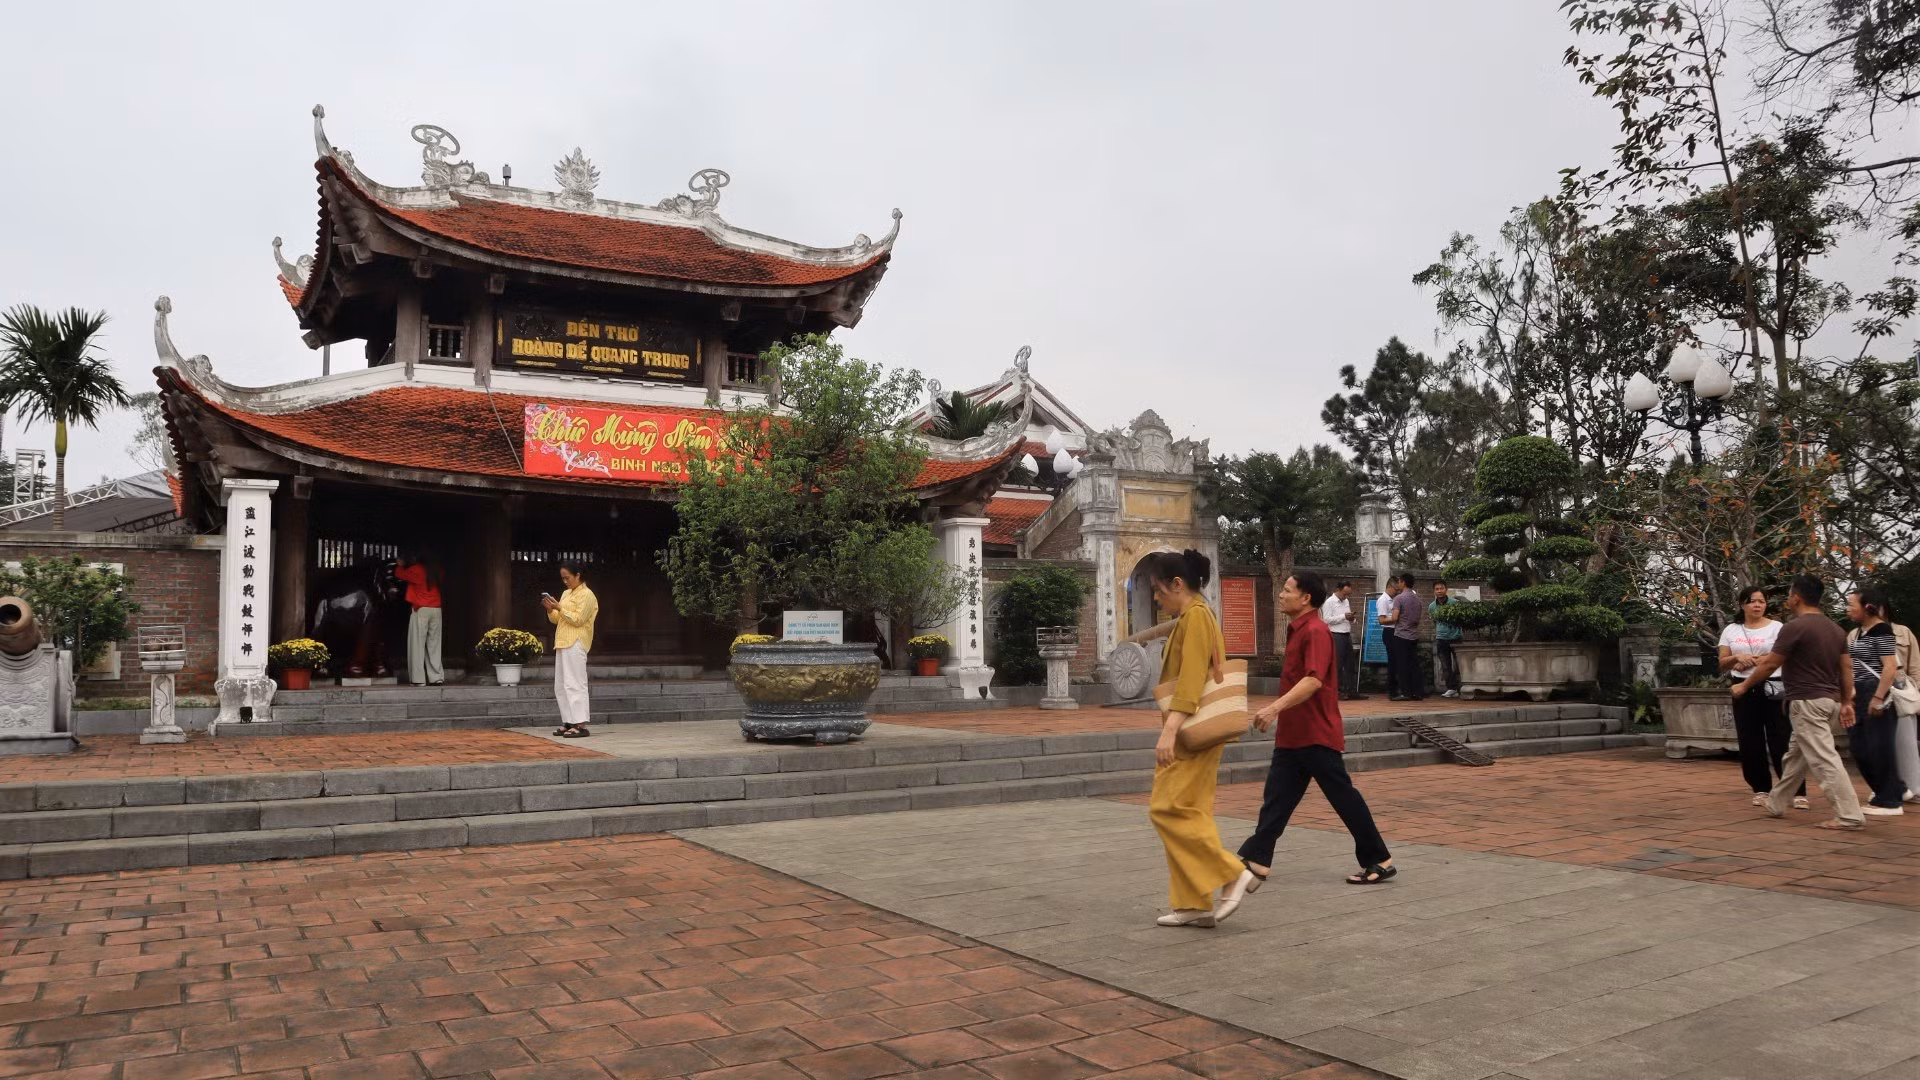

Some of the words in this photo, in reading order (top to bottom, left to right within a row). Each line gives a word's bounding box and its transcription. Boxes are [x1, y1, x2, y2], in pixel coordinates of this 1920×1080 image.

[605, 324, 640, 342] THỜ
[512, 336, 564, 359] HOÀNG
[566, 340, 587, 360] ĐẾ
[591, 346, 638, 365] QUANG
[642, 351, 690, 369] TRUNG
[532, 410, 590, 446] Chúc
[592, 413, 659, 455] Mừng
[611, 456, 646, 472] BÍNH
